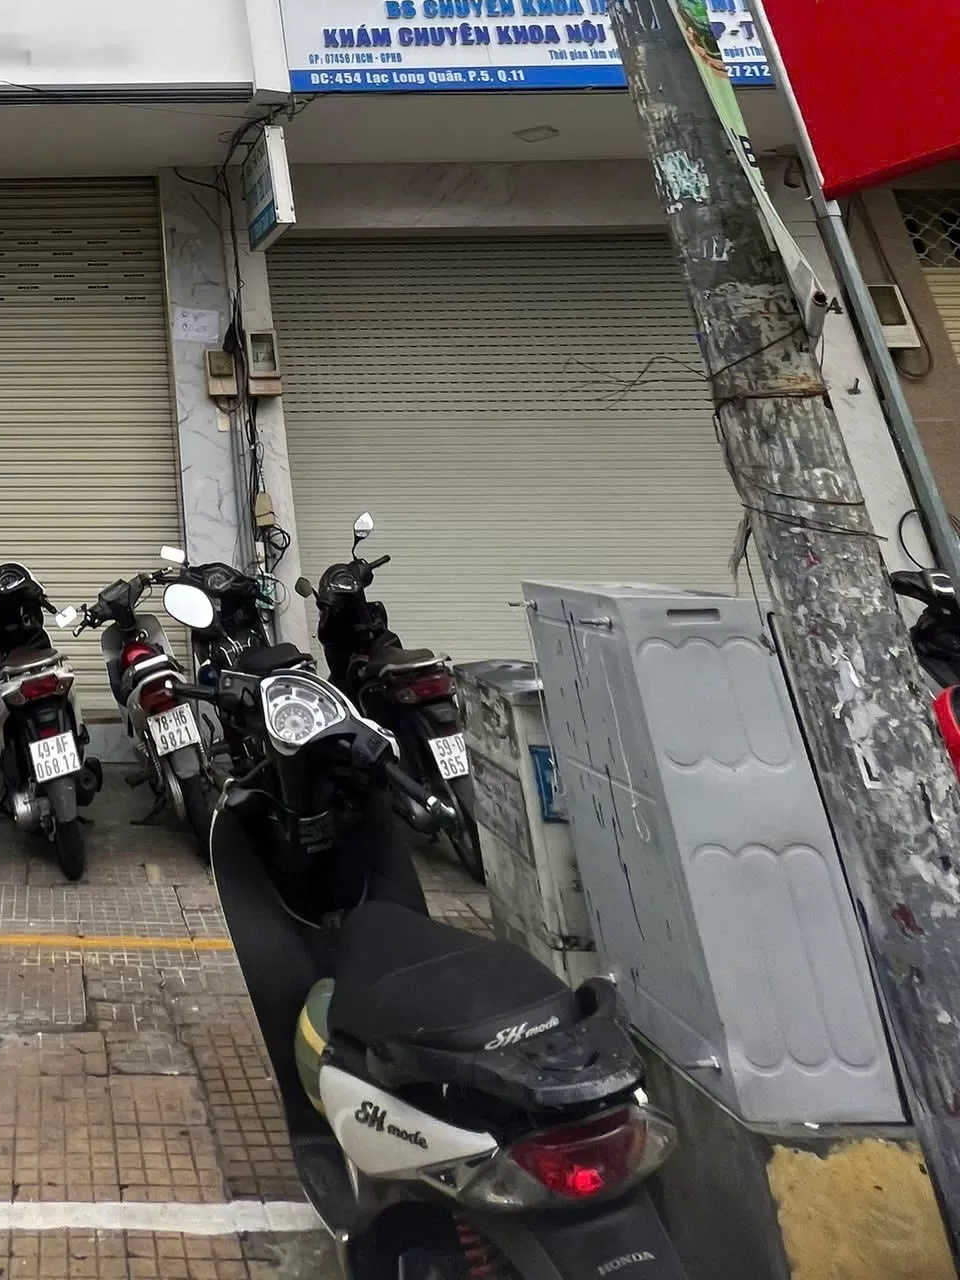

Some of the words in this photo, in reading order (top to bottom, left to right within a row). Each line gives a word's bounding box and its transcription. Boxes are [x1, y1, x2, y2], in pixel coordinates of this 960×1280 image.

[385, 0, 417, 19] BS
[323, 24, 392, 48] KHÁM
[398, 22, 491, 47] CHUYÊN
[496, 24, 561, 45] KHOA
[566, 19, 607, 47] NỘI
[365, 72, 389, 86] Lạc
[393, 71, 425, 85] Long
[428, 69, 467, 84] Quân,
[497, 69, 525, 83] Q.11
[155, 709, 187, 733] 78-H6
[160, 726, 192, 750] 9821
[36, 752, 79, 779] 068.12
[525, 1015, 560, 1039] mode
[386, 1122, 429, 1150] mode
[597, 1250, 656, 1276] HONDA
